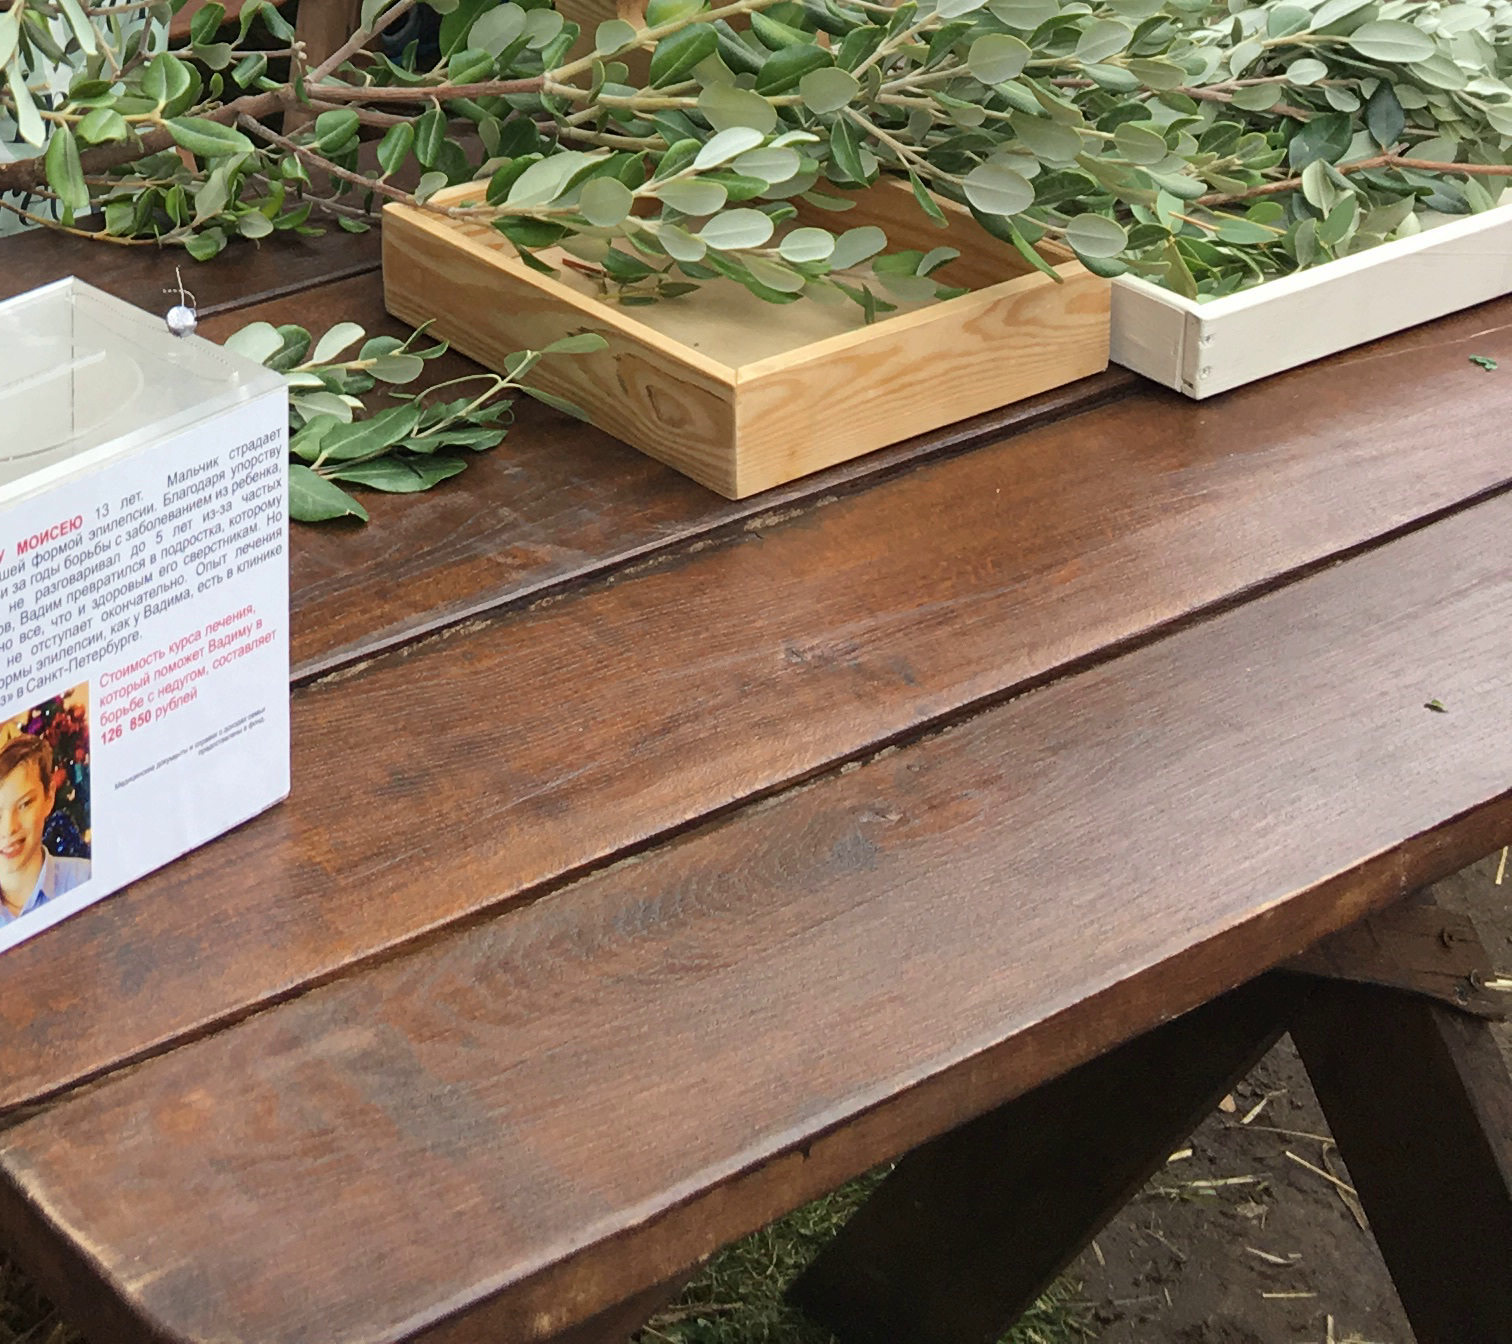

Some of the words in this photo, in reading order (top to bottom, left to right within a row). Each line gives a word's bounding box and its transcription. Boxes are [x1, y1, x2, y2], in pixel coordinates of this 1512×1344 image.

[9, 597, 25, 614] не
[35, 553, 121, 605] разговаривал
[130, 541, 146, 559] до
[156, 529, 163, 545] 5
[172, 519, 193, 537] лет
[202, 501, 232, 523] из-за
[241, 477, 282, 503] частых
[12, 579, 26, 594] за
[30, 563, 60, 586] годы
[64, 540, 111, 570] борьбы
[115, 534, 122, 546] с
[125, 493, 212, 541] заболеванием
[215, 486, 229, 500] из
[231, 463, 281, 496] ребенка,
[17, 514, 83, 556] МОИСЕЮ
[96, 503, 109, 519] 13
[120, 491, 142, 510] лет.
[167, 457, 219, 488] Мальчик
[229, 428, 281, 460] страдает
[31, 532, 83, 568] формой
[88, 503, 157, 541] эпилепсии.
[163, 470, 225, 507] Благодаря
[231, 444, 282, 480] упорству
[7, 652, 22, 668] не
[30, 617, 93, 656] отступает
[101, 574, 187, 622] окончательно.
[195, 553, 227, 576] Опыт
[235, 527, 282, 559] лечения
[19, 625, 45, 644] все,
[51, 610, 72, 627] что
[78, 603, 86, 617] и
[92, 572, 153, 610] здоровым
[158, 560, 178, 577] его
[183, 522, 260, 566] сверстникам.
[267, 511, 283, 526] Но
[20, 597, 62, 626] Вадим
[66, 558, 146, 604] превратился
[150, 553, 157, 565] в
[161, 523, 225, 559] подростка,
[229, 494, 282, 528] которому
[36, 630, 106, 672] эпилепсии,
[110, 617, 130, 635] как
[133, 612, 140, 628] у
[143, 588, 193, 619] Вадима,
[197, 574, 223, 593] есть
[227, 568, 233, 579] в
[237, 544, 283, 574] клинике
[16, 686, 24, 699] в
[26, 630, 142, 693] Санкт-Петербурге.
[99, 649, 166, 688] Стоимость
[169, 630, 202, 655] курса
[205, 604, 256, 637] лечения,
[99, 672, 150, 708] который
[154, 647, 205, 681] поможет
[208, 623, 253, 654] Вадиму
[256, 618, 263, 630] в
[100, 696, 144, 727] борьбе
[147, 691, 154, 703] с
[158, 666, 209, 698] недугом,
[212, 629, 276, 670] составляет
[101, 724, 123, 745] 126
[130, 709, 152, 731] 850
[155, 687, 197, 721] рублей
